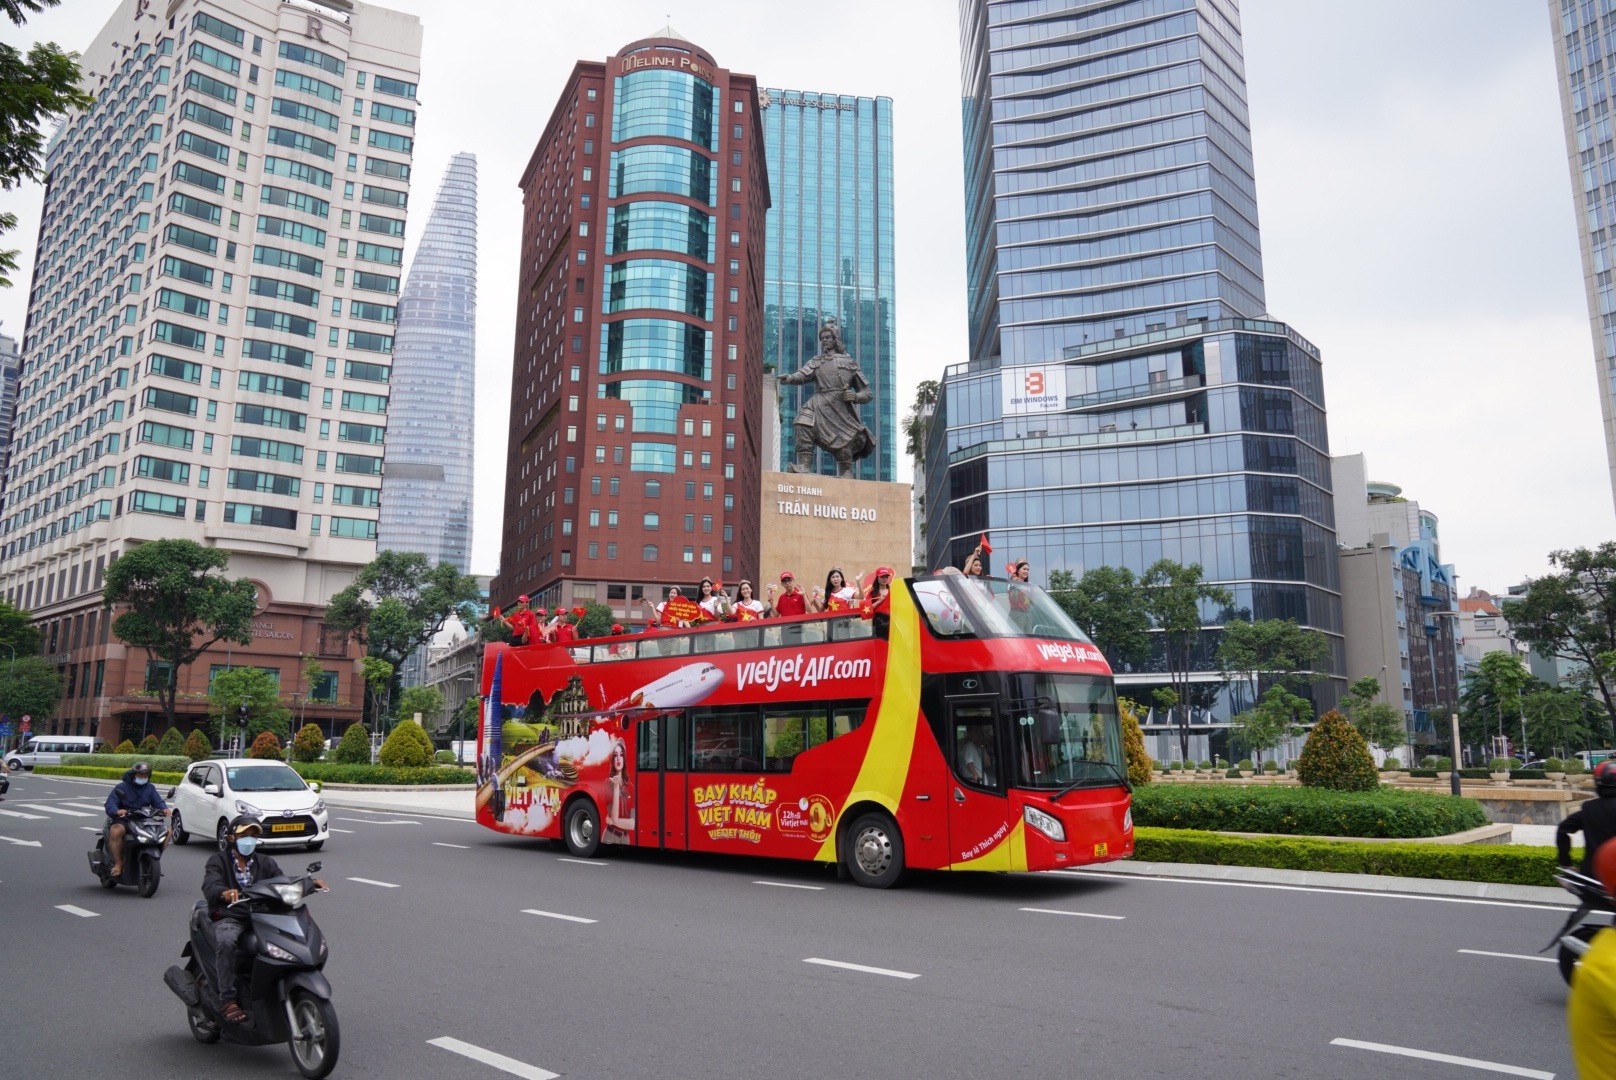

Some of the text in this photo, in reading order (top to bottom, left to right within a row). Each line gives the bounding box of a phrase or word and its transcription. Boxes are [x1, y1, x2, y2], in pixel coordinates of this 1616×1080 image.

[305, 15, 329, 43] R
[810, 99, 853, 111] SQUARE
[1023, 395, 1059, 404] WINDOWS
[777, 498, 877, 524] TRẦN HƯNG ĐẠO
[693, 784, 727, 808] BAY
[698, 802, 772, 829] VIỆT NAM
